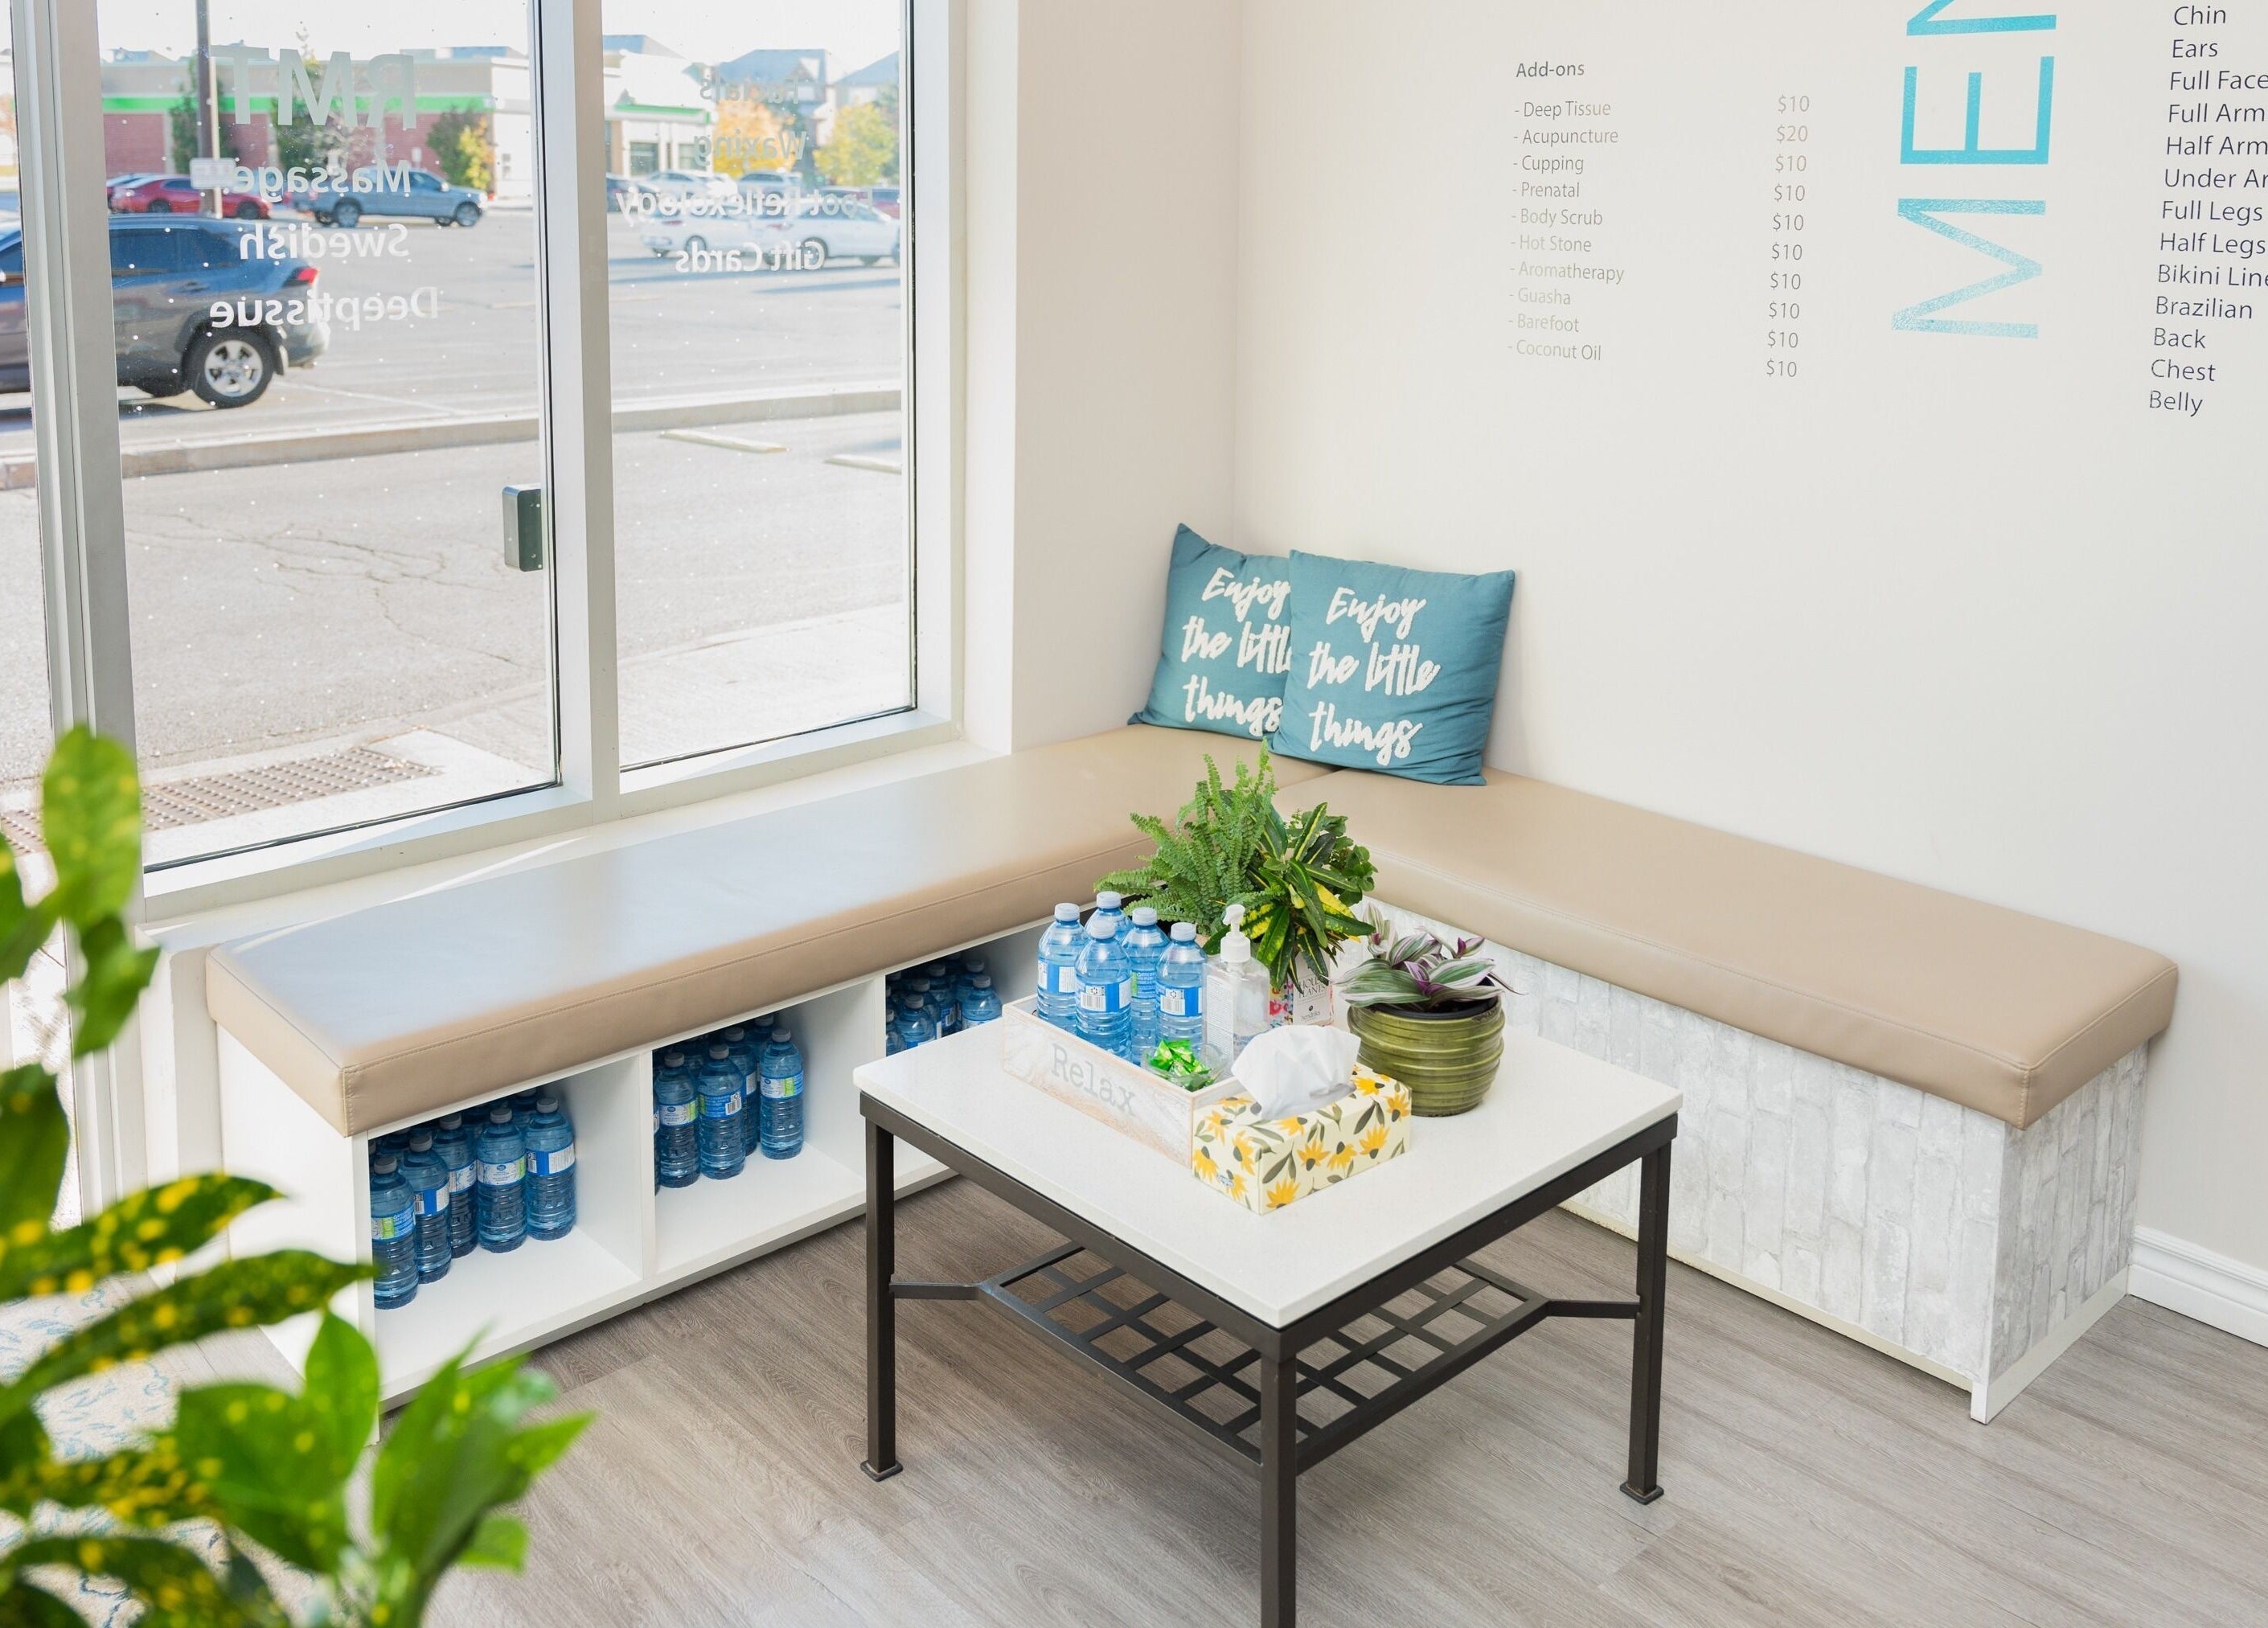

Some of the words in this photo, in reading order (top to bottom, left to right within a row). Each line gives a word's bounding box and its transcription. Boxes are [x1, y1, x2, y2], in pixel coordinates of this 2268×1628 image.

[2174, 5, 2226, 26] Chin
[2172, 39, 2218, 58] Ears
[1515, 61, 1585, 78] Add-ons
[2170, 70, 2209, 90] Full
[2218, 70, 2268, 90] Face
[1524, 101, 1562, 120] Deep
[1565, 100, 1611, 117] Tissue
[1778, 94, 1809, 114] $10
[2169, 103, 2208, 123] Full
[2216, 103, 2266, 122] Arm
[1523, 129, 1619, 148] Acupuncture
[1777, 125, 1808, 144] $20
[2167, 135, 2214, 155] Half
[2219, 137, 2268, 155] Arm
[1522, 155, 1585, 175] Cupping
[1775, 154, 1807, 173] $10
[2164, 168, 2237, 188] Under
[1521, 182, 1580, 199] Prenatal
[1774, 183, 1805, 203] $10
[1520, 208, 1557, 228] Body
[1561, 208, 1603, 226] Scrub
[1772, 212, 1803, 232] $10
[2163, 200, 2201, 219] Full
[2210, 201, 2263, 226] Legs
[1520, 234, 1545, 251] Hot
[1549, 235, 1592, 252] Stone
[1771, 242, 1803, 261] $10
[2160, 232, 2207, 252] Half
[2213, 234, 2266, 259] Legs
[1519, 261, 1625, 285] Aromatherapy
[1770, 271, 1801, 290] $10
[2158, 264, 2220, 285] Bikini
[1518, 287, 1571, 306] Guasha
[1769, 301, 1799, 320] $10
[2155, 296, 2253, 319] Brazilian
[1517, 314, 1580, 333] Barefoot
[1767, 330, 1798, 349] $10
[2154, 327, 2206, 349] Back
[1516, 339, 1577, 359] Coconut
[1581, 344, 1602, 361] Oil
[1766, 359, 1797, 378] $10
[2151, 359, 2217, 382] Chest
[2150, 390, 2204, 417] Belly
[1201, 567, 1290, 622] Enjoy
[1326, 587, 1426, 642] Enjoy
[1181, 615, 1232, 662] the
[1237, 621, 1291, 674] littl
[1307, 642, 1360, 689] the
[1364, 642, 1441, 696] little
[1183, 674, 1283, 736] things
[1309, 701, 1423, 766] things
[1051, 1044, 1135, 1116] Relax
